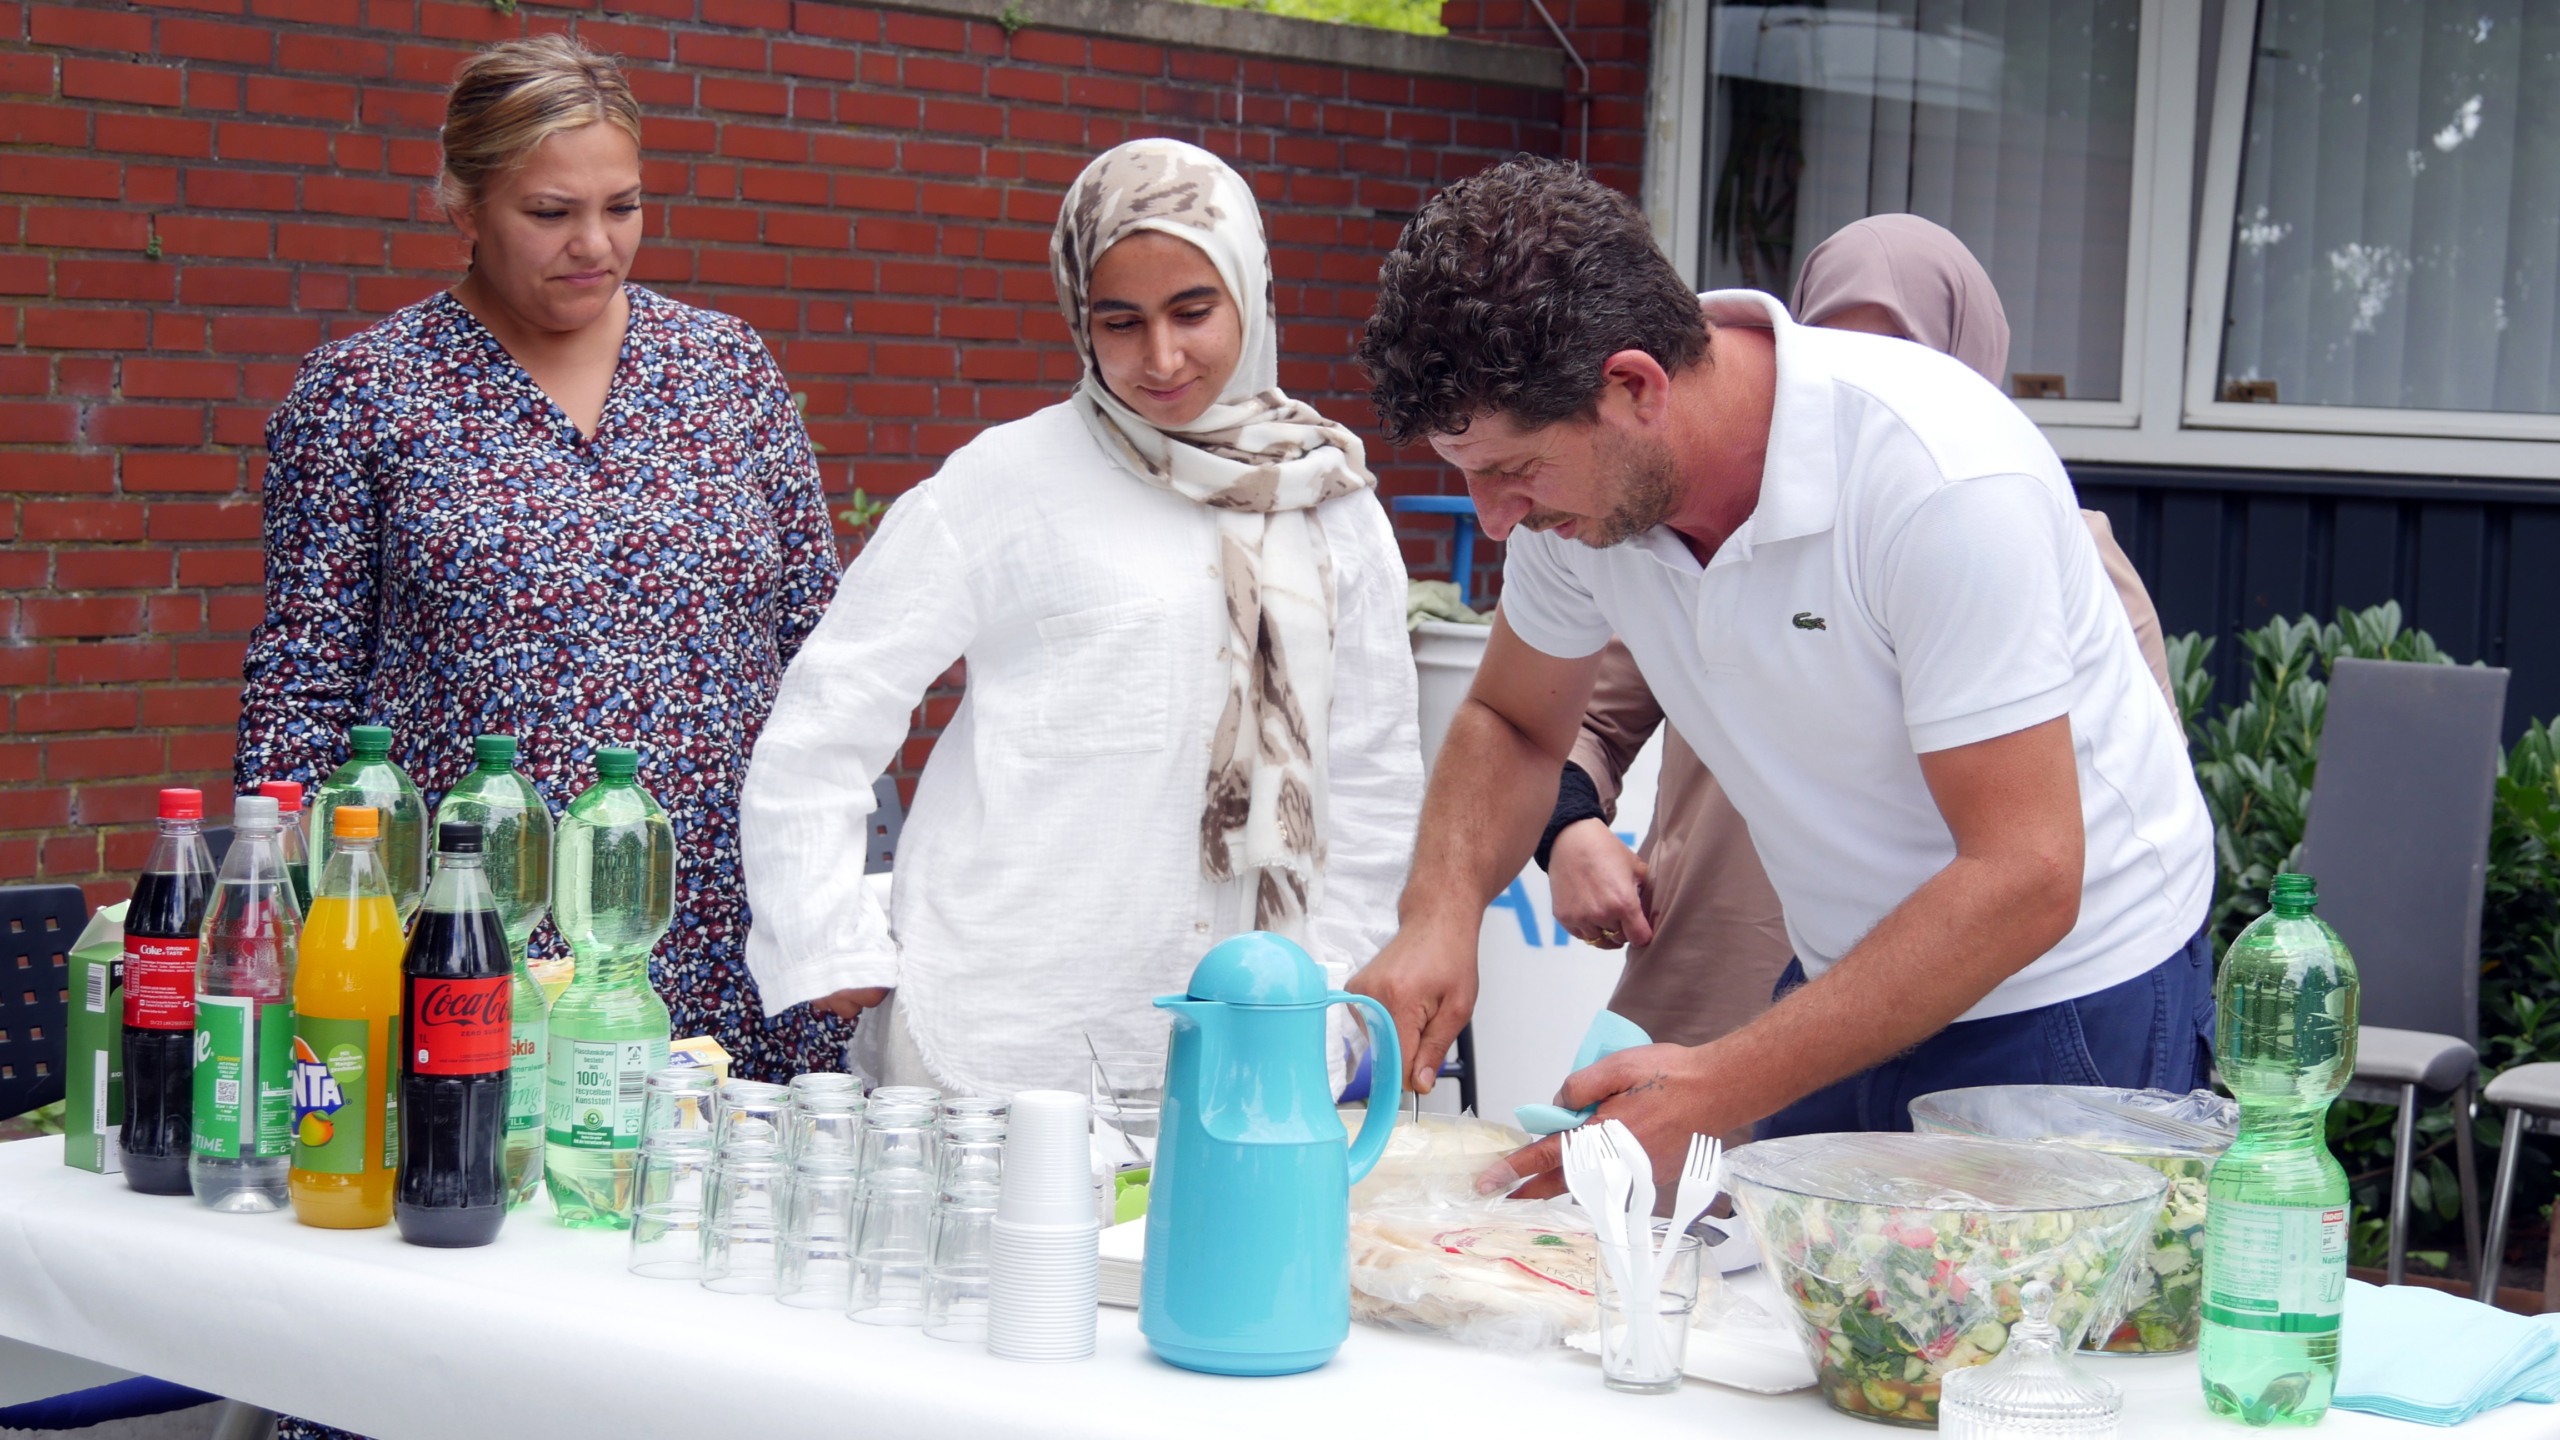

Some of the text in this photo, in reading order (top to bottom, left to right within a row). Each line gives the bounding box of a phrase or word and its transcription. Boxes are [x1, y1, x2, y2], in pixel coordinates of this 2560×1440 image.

[140, 944, 163, 955] Coke
[421, 979, 512, 1027] Coca-Co
[484, 1027, 504, 1035] SUGAR
[418, 1034, 429, 1043] 1L
[511, 1039, 535, 1056] skia
[574, 1047, 615, 1056] Flaschenkörper
[576, 1070, 612, 1087] 100%
[292, 1063, 342, 1107] NTA
[575, 1088, 612, 1096] recyceltem
[575, 1096, 611, 1106] Kunststoff
[196, 1134, 226, 1153] TIME.
